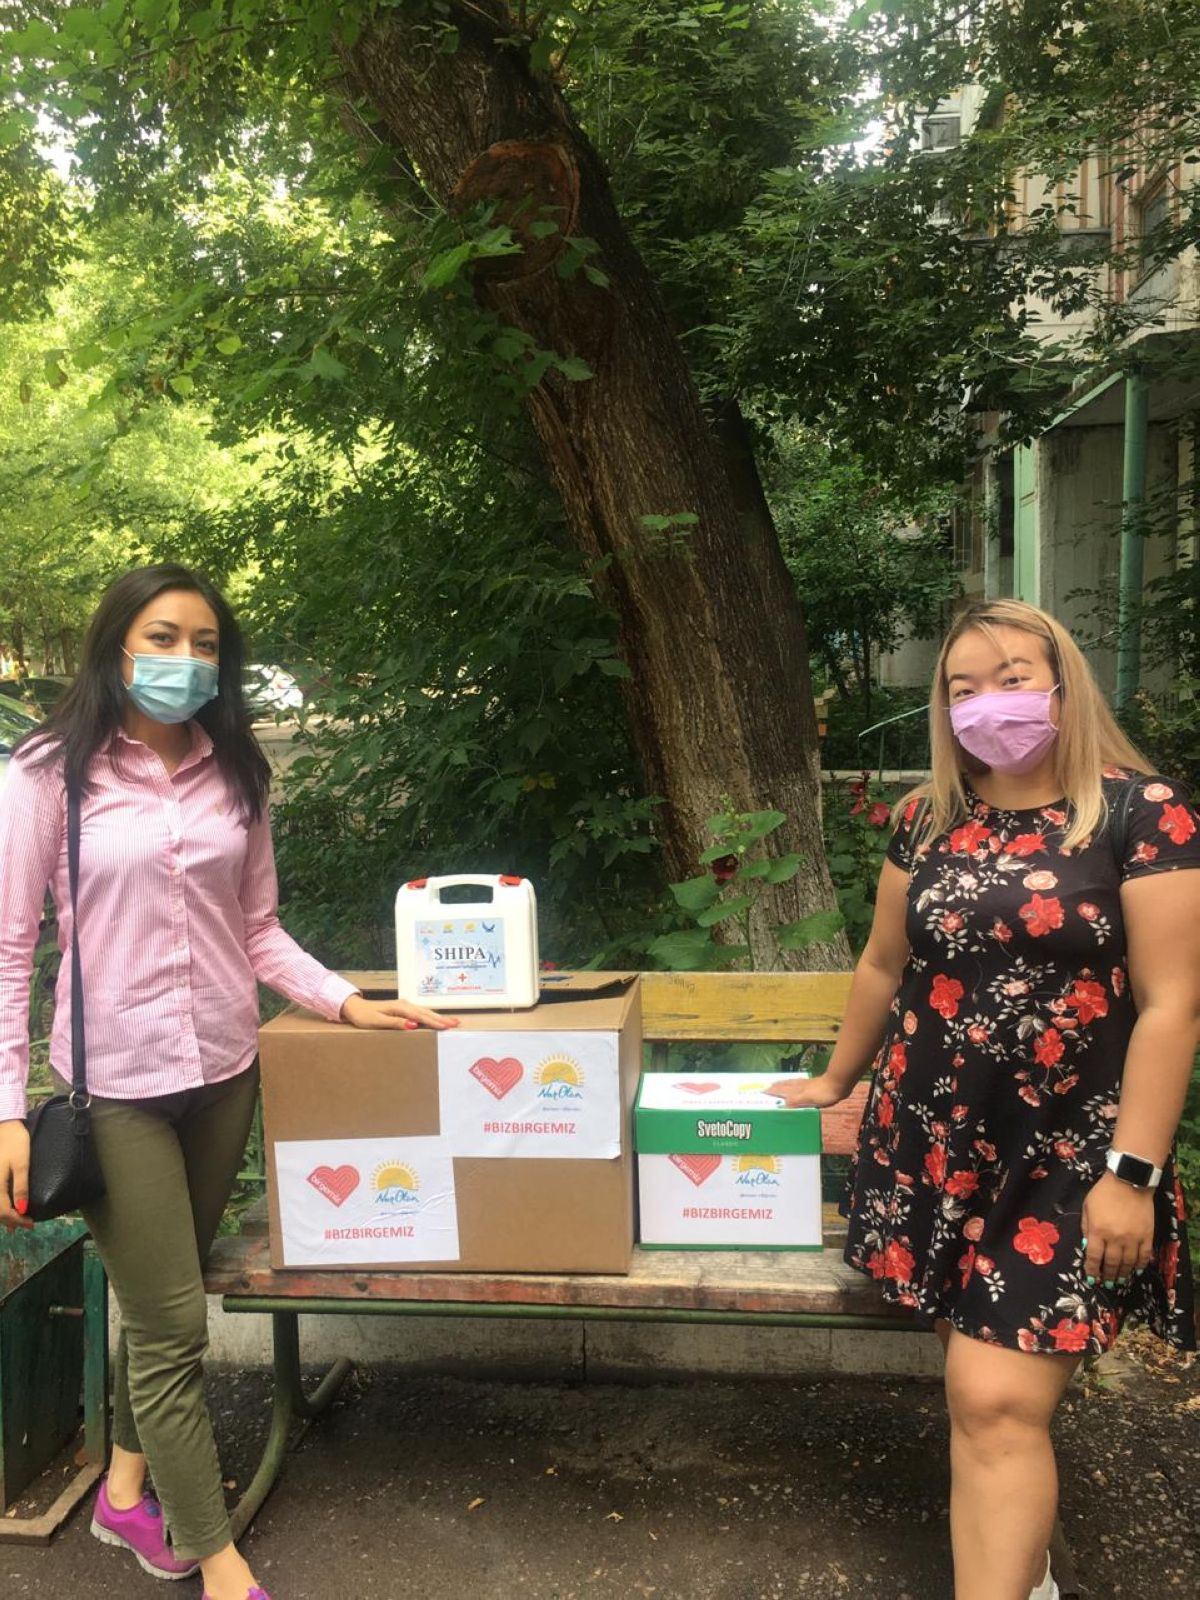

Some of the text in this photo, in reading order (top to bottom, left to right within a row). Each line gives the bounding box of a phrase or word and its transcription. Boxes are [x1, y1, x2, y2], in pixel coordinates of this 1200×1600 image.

[434, 947, 486, 960] SHIPA
[483, 1122, 576, 1135] #BIZBIRGEMIZ
[697, 1119, 751, 1140] SvetoCopy
[682, 1207, 773, 1220] #BIZBIRGEMIZ
[324, 1226, 415, 1240] #BIZBIRGEMIZ
